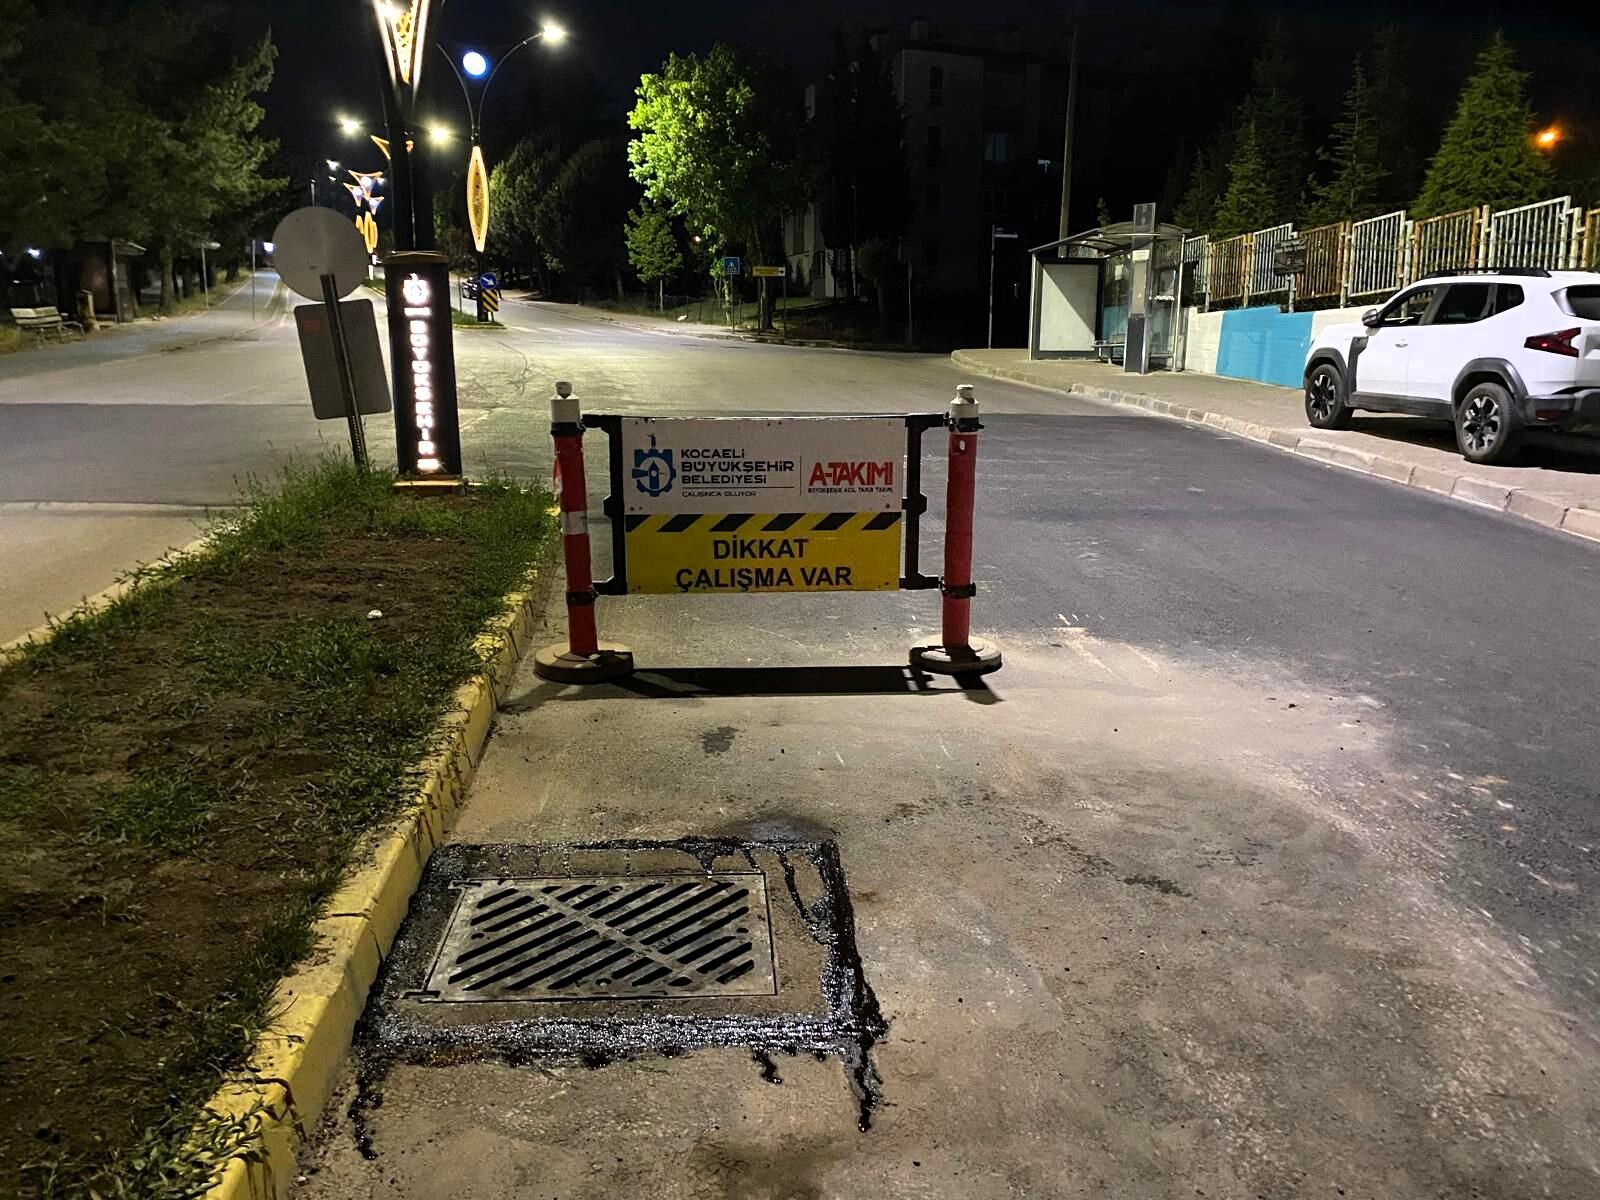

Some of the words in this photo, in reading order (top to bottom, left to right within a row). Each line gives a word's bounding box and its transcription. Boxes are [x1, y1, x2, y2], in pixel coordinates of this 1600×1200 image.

[681, 448, 745, 459] KOCAELİ
[681, 460, 795, 473] BÜYÜKŞEHİR
[808, 461, 894, 486] A-TAKIMI
[681, 474, 767, 484] BELEDİYESİ
[713, 535, 809, 560] DİKKAT
[676, 567, 794, 592] ÇALIŞMA
[800, 566, 853, 587] VAR
